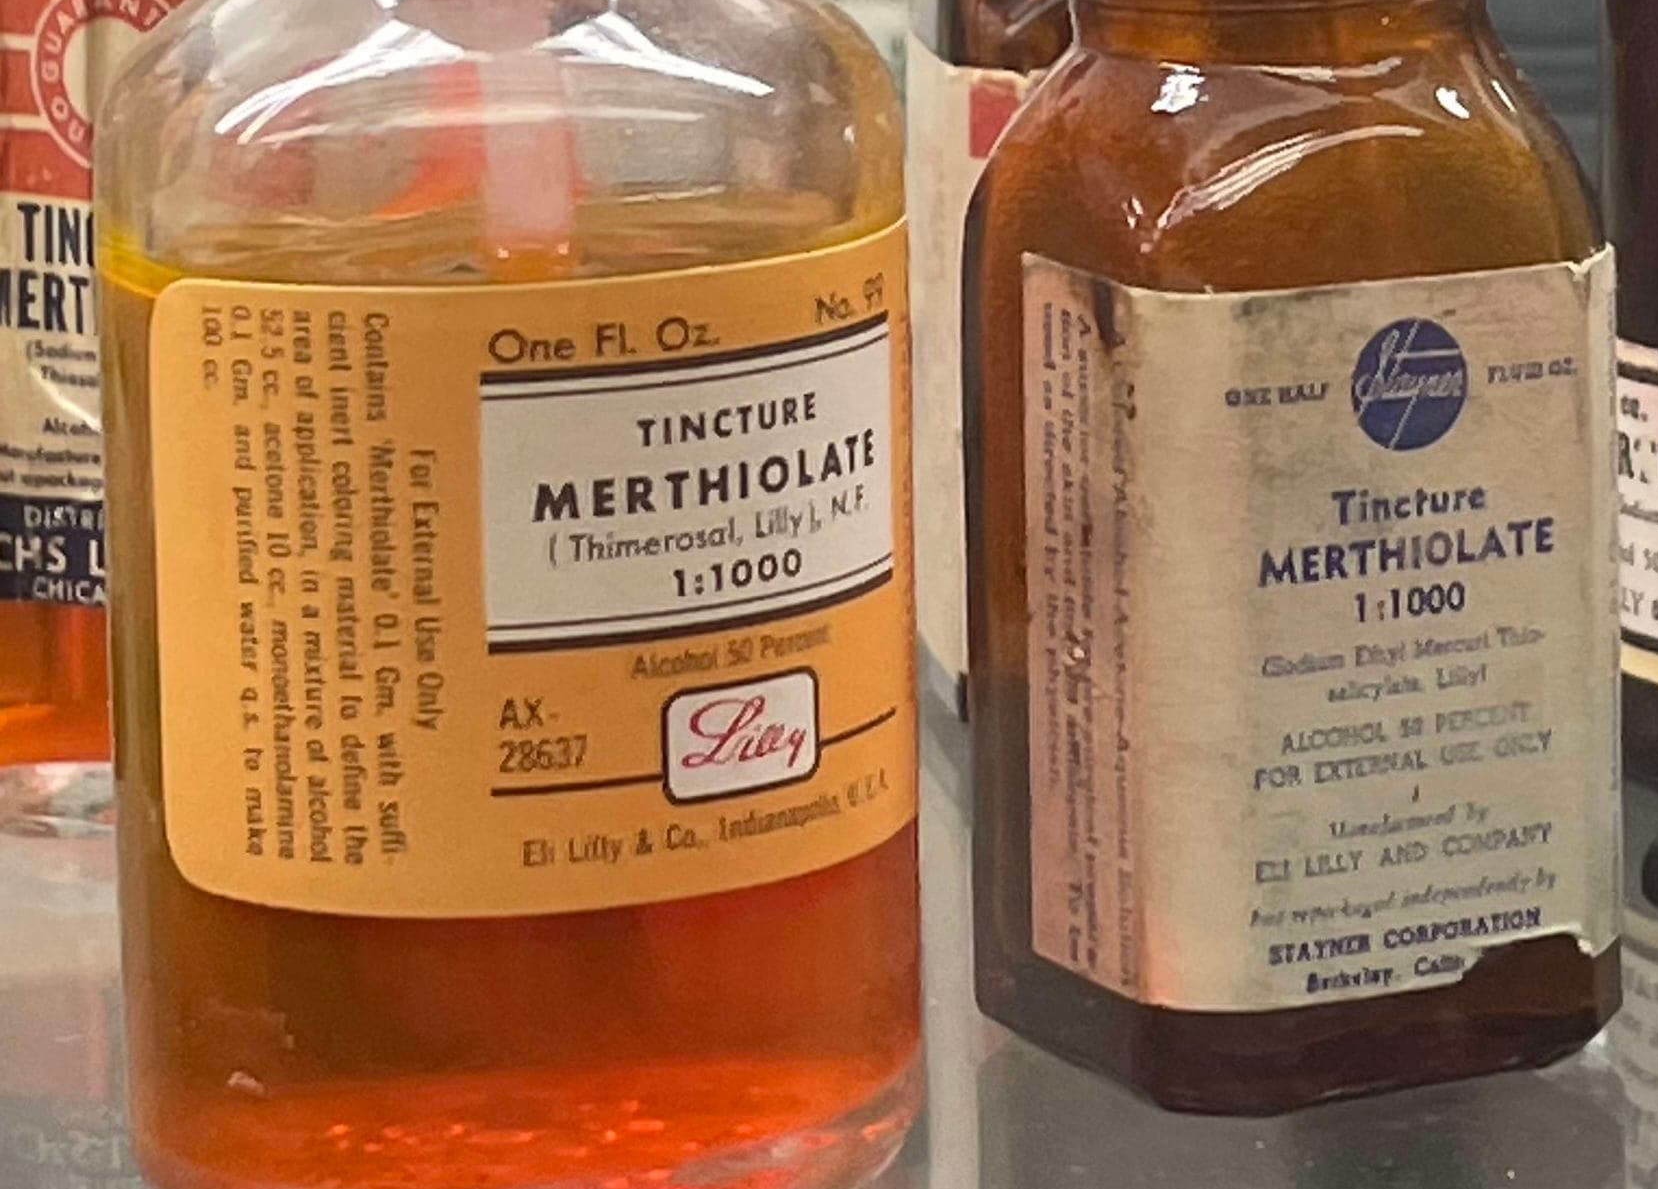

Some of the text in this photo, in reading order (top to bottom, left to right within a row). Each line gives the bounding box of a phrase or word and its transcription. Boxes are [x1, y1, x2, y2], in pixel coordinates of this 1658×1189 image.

[202, 306, 223, 348] 100
[292, 310, 313, 364] area
[488, 328, 576, 364] One
[596, 322, 636, 357] Fl.
[656, 316, 720, 353] Oz.
[294, 375, 320, 400] of
[363, 312, 390, 422] Contains
[636, 391, 817, 448] TINCTURE
[233, 424, 257, 472] and
[263, 422, 286, 520] acetone
[531, 427, 876, 524] MERTHIOLATE
[1332, 486, 1487, 526] Tincture
[232, 486, 259, 585] purified
[266, 532, 292, 558] 10
[1258, 516, 1555, 588] MERTHIOLATE
[302, 569, 320, 593] in
[327, 311, 368, 865] cient inert coloring material to define the
[409, 449, 445, 731] For External Use Only
[672, 548, 802, 597] 1:1000
[301, 604, 321, 619] a
[1354, 580, 1465, 623] 1:1000
[239, 602, 258, 673] water
[303, 631, 327, 730] mixture
[630, 649, 719, 680] Alcohol
[374, 666, 401, 717] Gm.
[499, 697, 560, 730] AX-
[305, 739, 330, 764] of
[499, 735, 588, 773] 28637
[681, 694, 808, 769] Lilly
[1281, 722, 1388, 755] ALCOHOL
[243, 747, 264, 772] to
[377, 733, 405, 787] with
[1253, 728, 1554, 791] FOR EXTERNAL USE ONLY
[245, 787, 267, 857] make
[307, 775, 333, 863] alcohol
[522, 829, 654, 868] Eli Lilly &
[1255, 821, 1553, 883] ELI LILLY AND COMPANY
[1268, 907, 1543, 966] STAYNER CORPORATION
